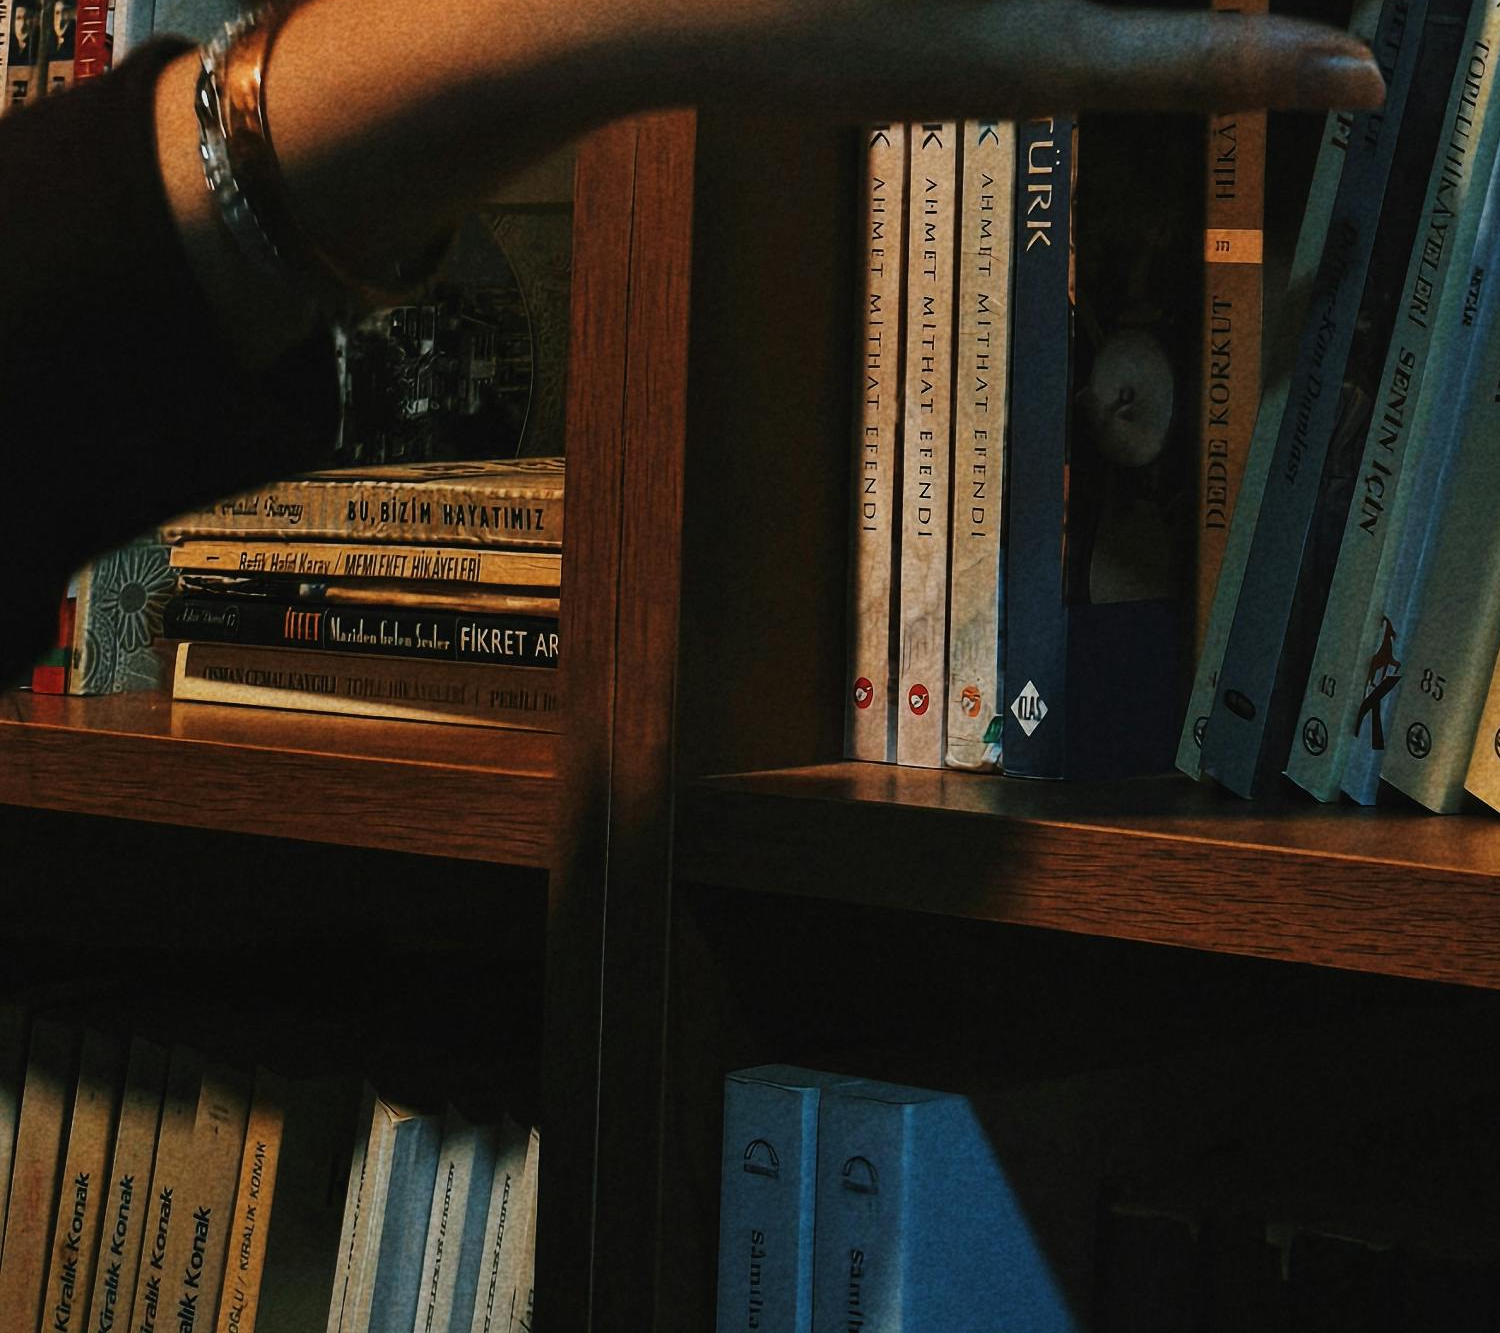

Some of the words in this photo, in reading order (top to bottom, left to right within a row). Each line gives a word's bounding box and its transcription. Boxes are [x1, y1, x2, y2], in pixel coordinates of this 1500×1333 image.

[922, 178, 938, 282] AHMET
[443, 503, 544, 530] HAYATIMIZ
[461, 623, 527, 655] FİKRET
[107, 1175, 135, 1255] Konak
